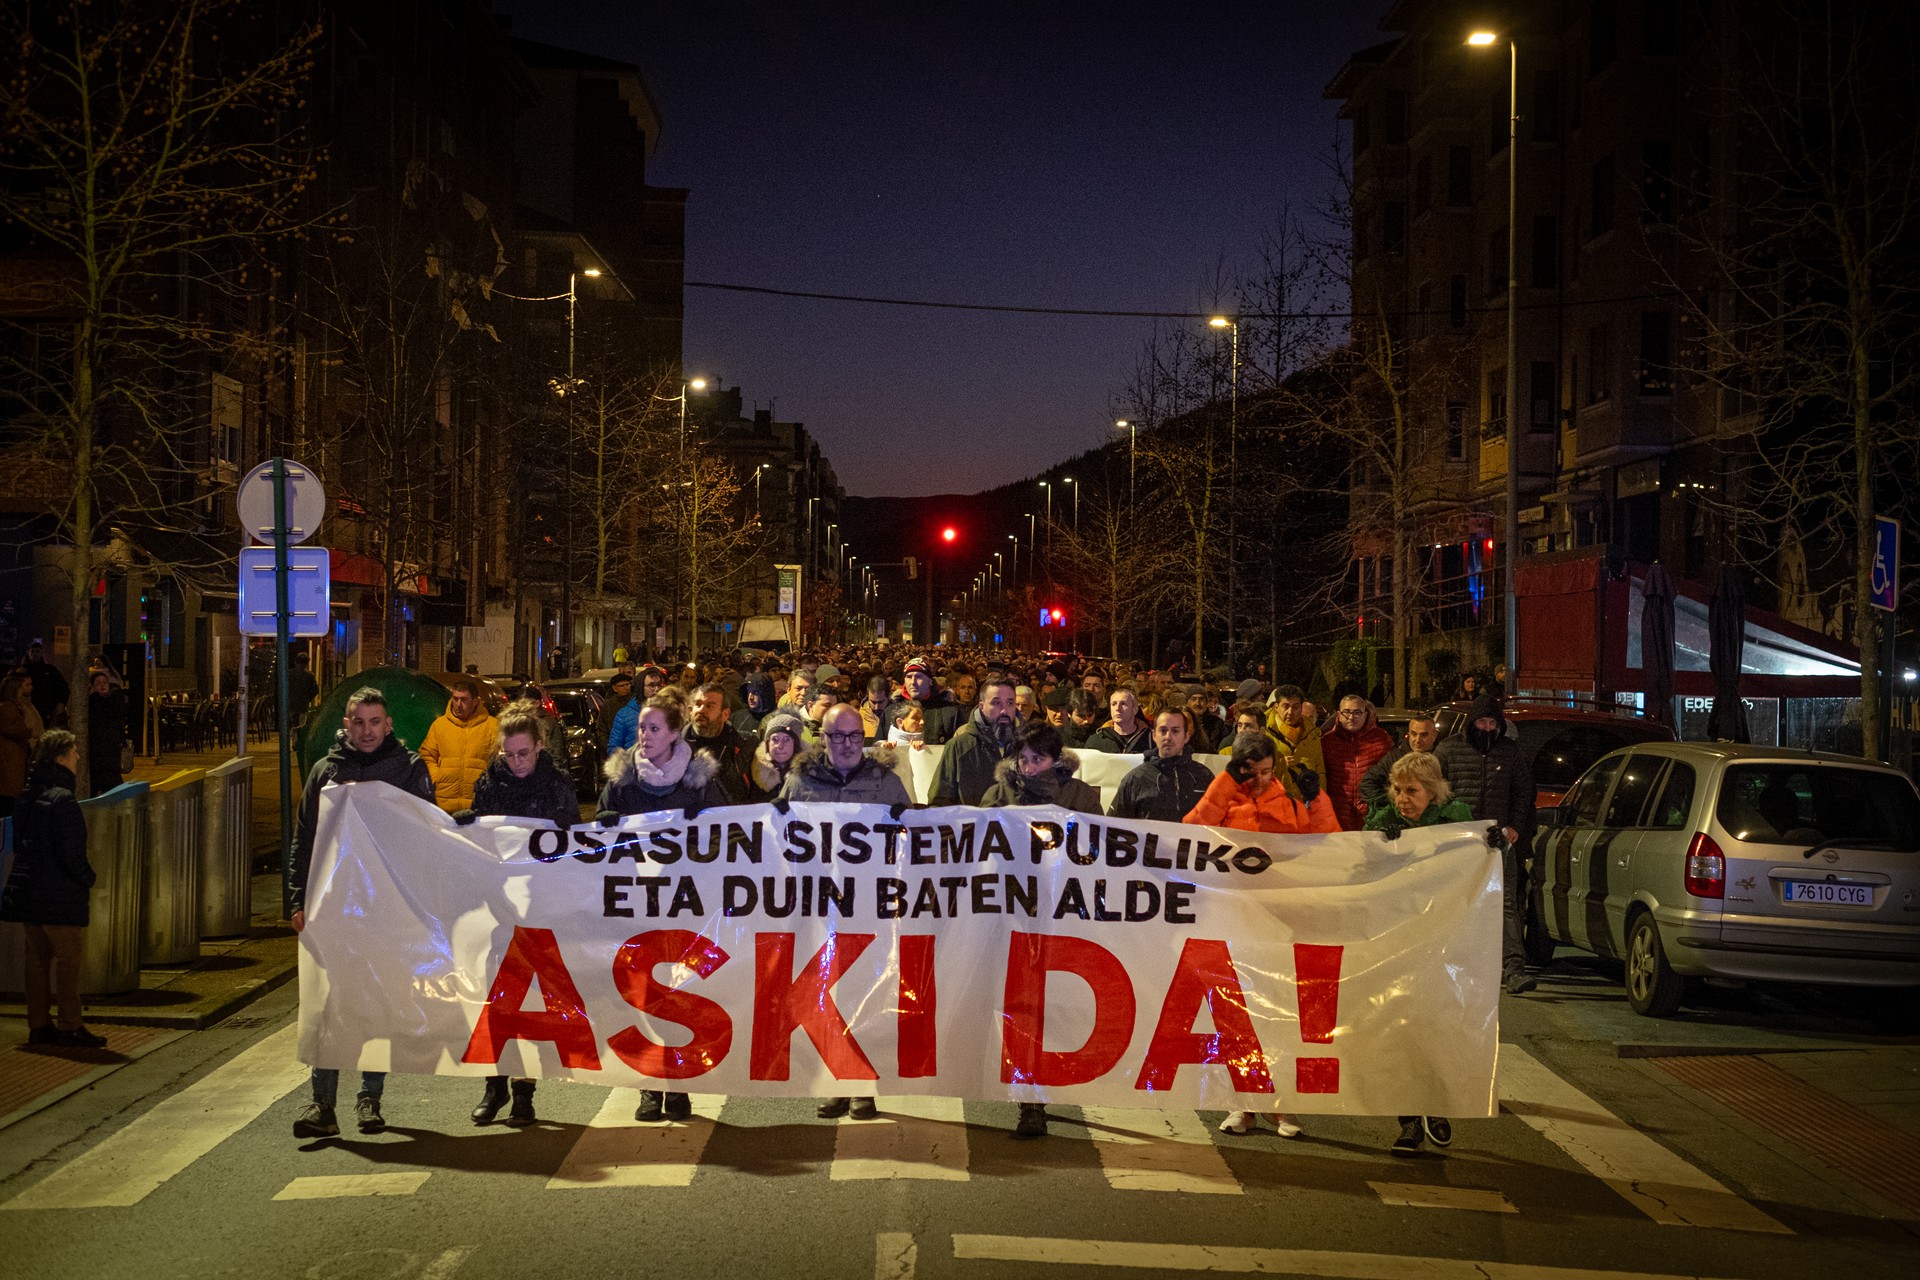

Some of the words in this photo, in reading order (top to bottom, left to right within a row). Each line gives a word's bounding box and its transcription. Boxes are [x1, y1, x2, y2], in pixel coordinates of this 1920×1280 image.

[1685, 697, 1714, 709] EDE
[528, 821, 763, 864] OSASUN
[783, 821, 1015, 865] SISTEMA
[1030, 821, 1273, 875] PUBLIKO
[603, 874, 705, 918] ETA
[722, 874, 856, 918] DUIN
[876, 873, 1038, 919] BATEN
[1052, 878, 1196, 924] ALDE
[1798, 884, 1834, 901] 7610
[1838, 887, 1865, 903] CYG
[461, 924, 937, 1082] ASKI
[1000, 930, 1344, 1094] DA!
